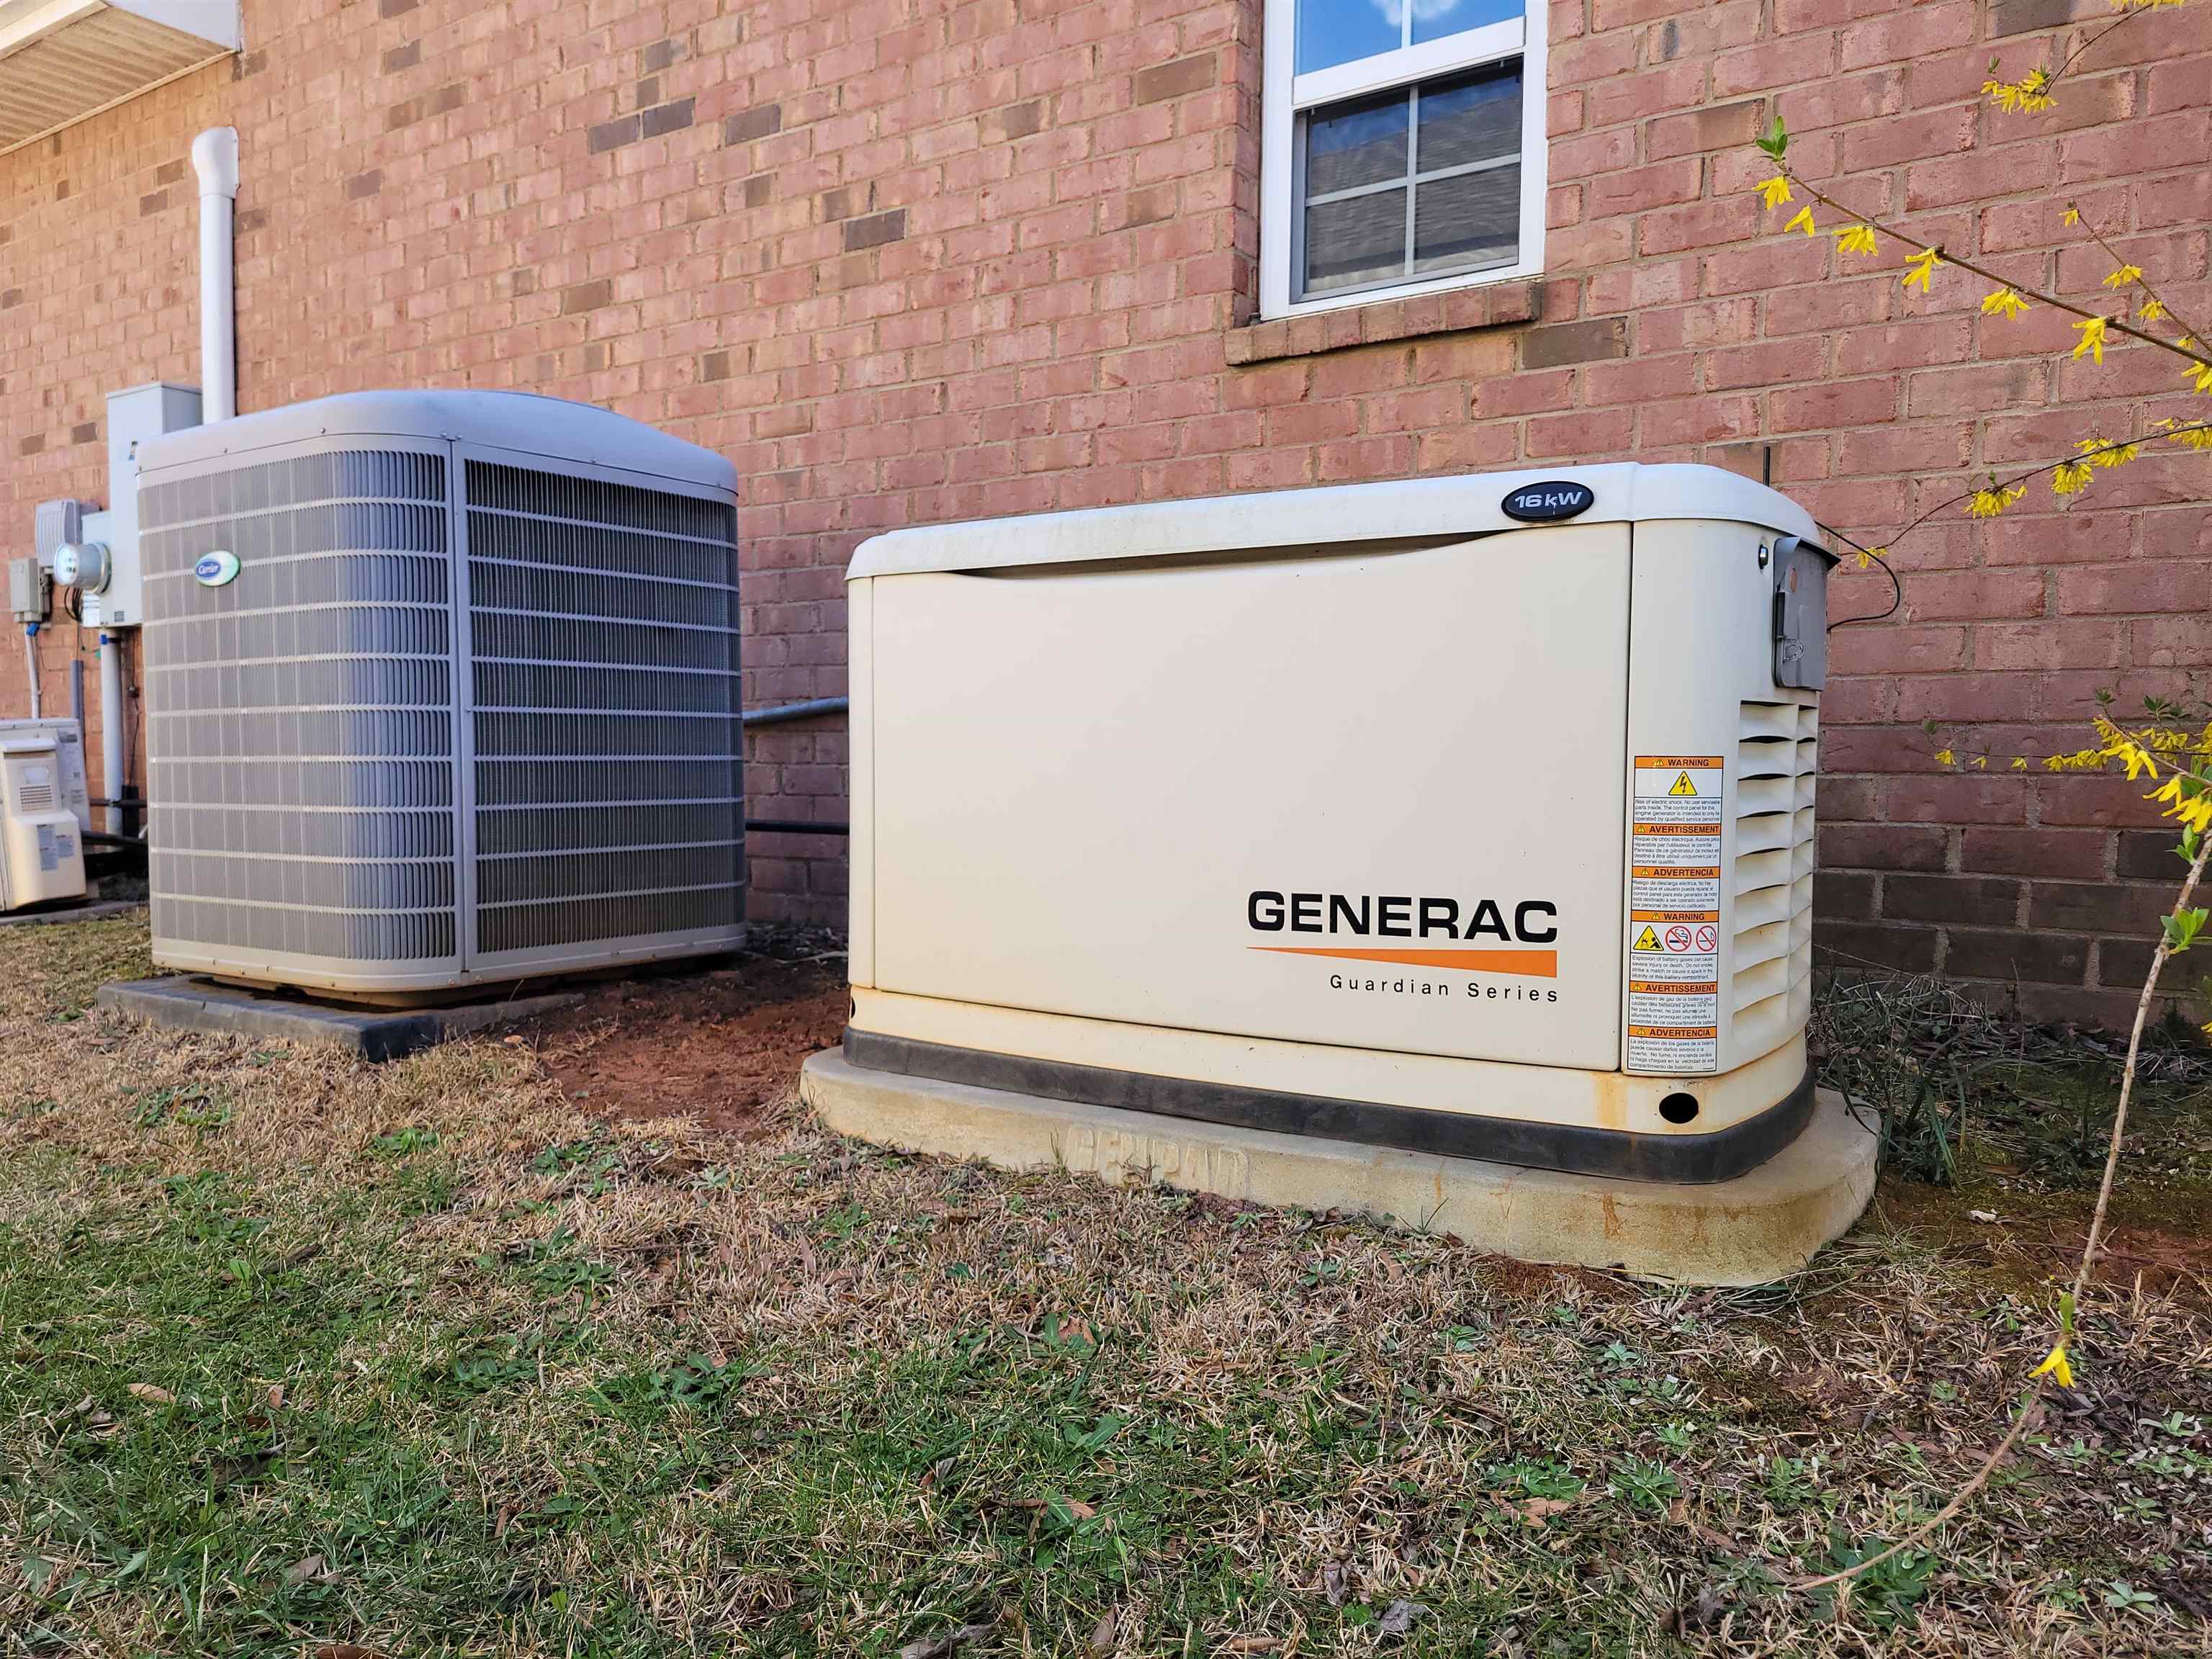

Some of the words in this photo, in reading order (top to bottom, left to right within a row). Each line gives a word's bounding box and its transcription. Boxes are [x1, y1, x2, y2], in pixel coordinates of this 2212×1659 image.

[1649, 825, 1719, 834] AVERTISSEMENT
[1248, 891, 1557, 943] GENERAC
[1330, 974, 1449, 996] Guardian
[1467, 982, 1557, 1002] Series
[1645, 984, 1715, 993] AVERTISSEMENT
[1650, 1028, 1711, 1037] ADVERTENCIA
